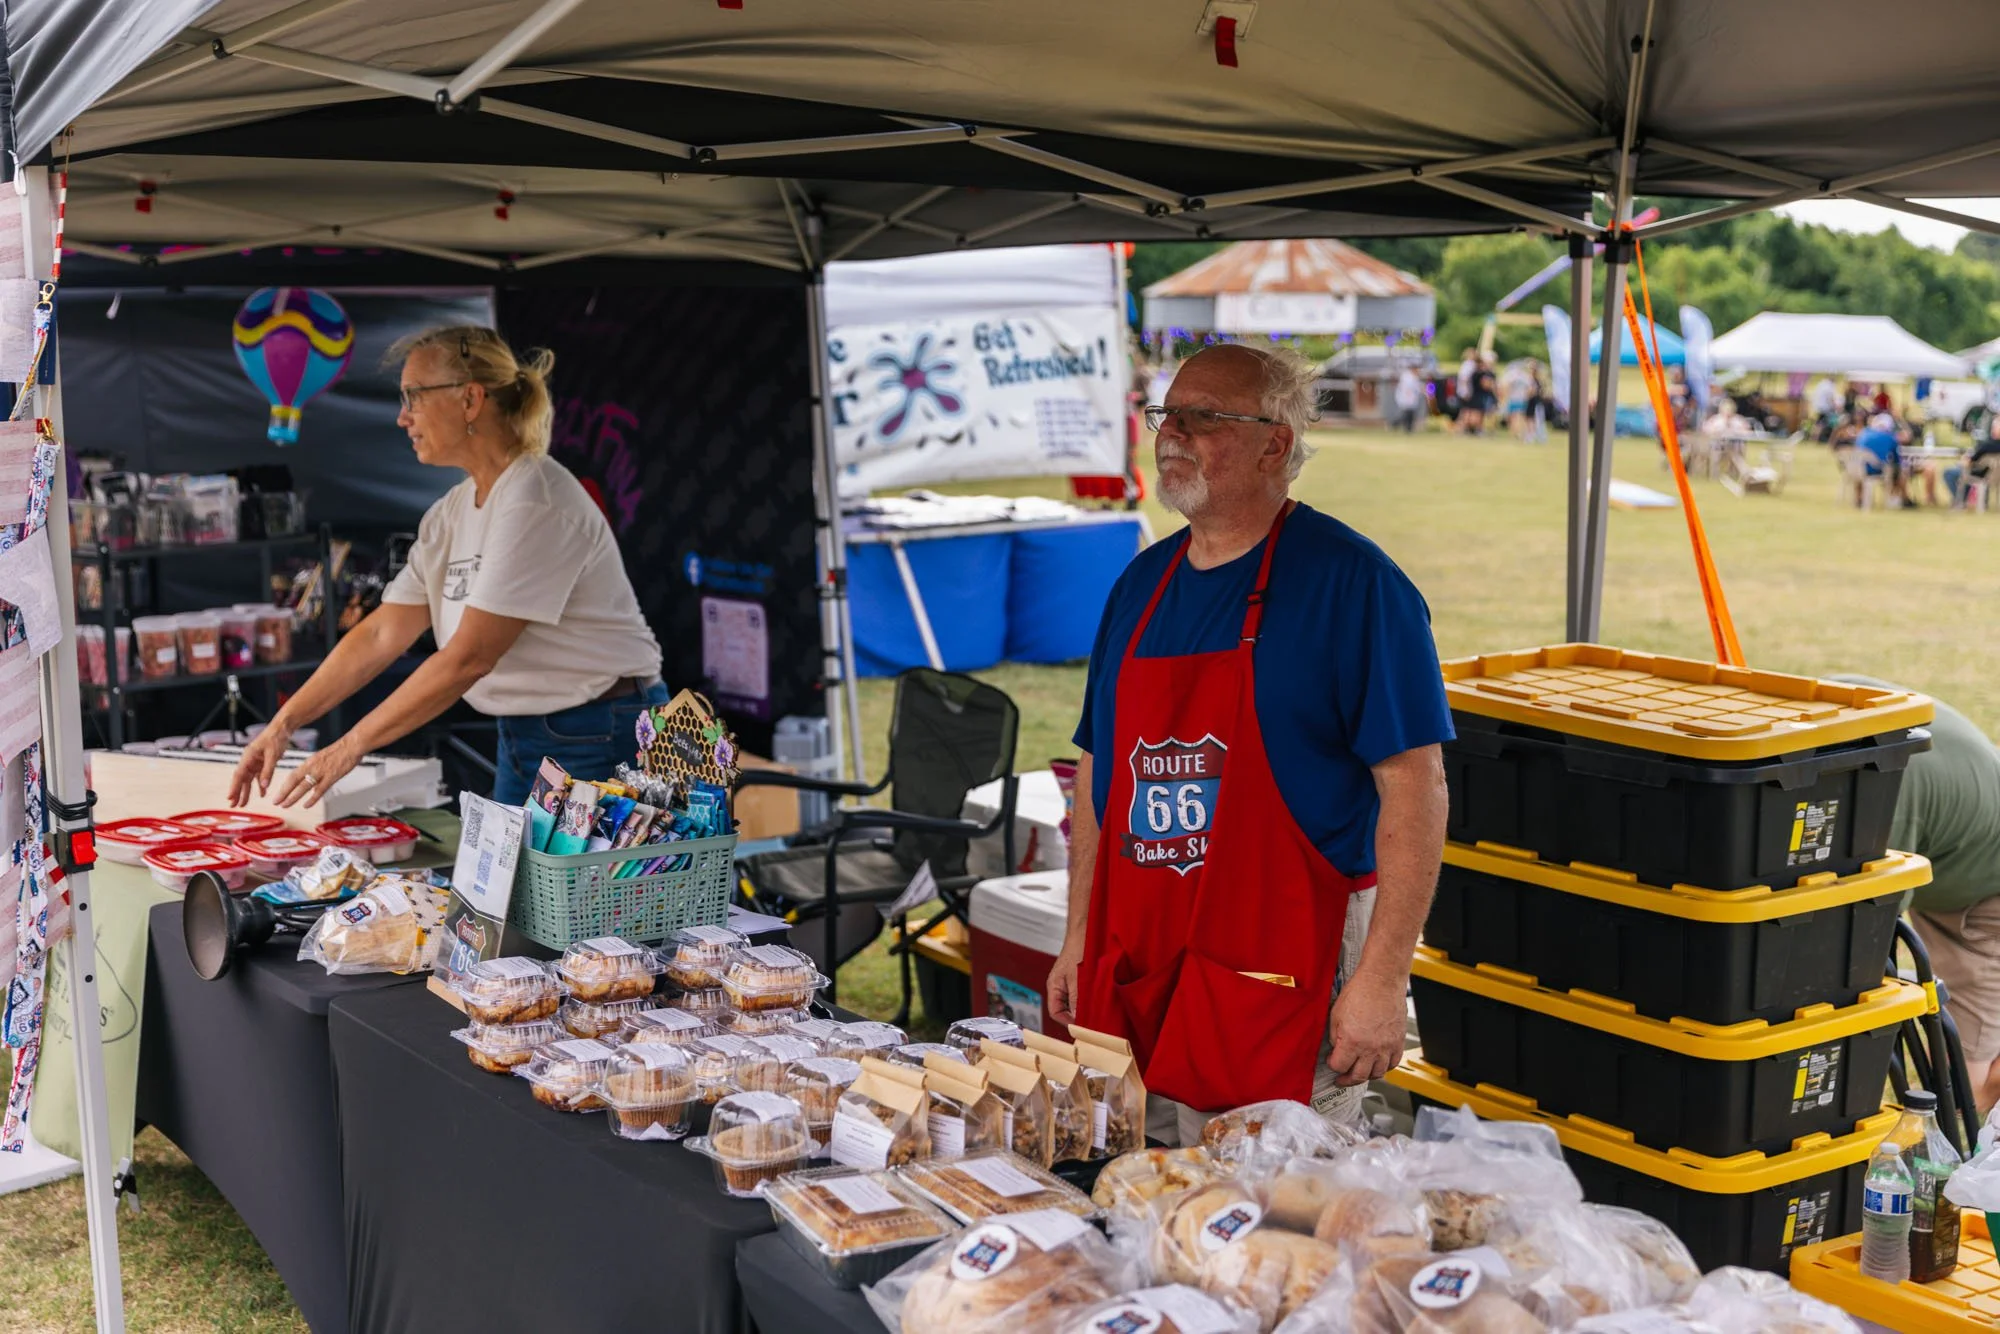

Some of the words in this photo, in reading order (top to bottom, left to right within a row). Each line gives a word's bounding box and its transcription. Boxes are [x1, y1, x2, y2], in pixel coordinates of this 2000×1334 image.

[973, 321, 1017, 352] Get
[984, 336, 1110, 388] Refreshed!
[1143, 754, 1206, 776] ROUTE
[1146, 783, 1207, 833] 66
[1134, 842, 1179, 863] Bake
[461, 925, 480, 946] ROUTE
[457, 944, 476, 972] 66
[1317, 1088, 1348, 1106] UNIONBAY
